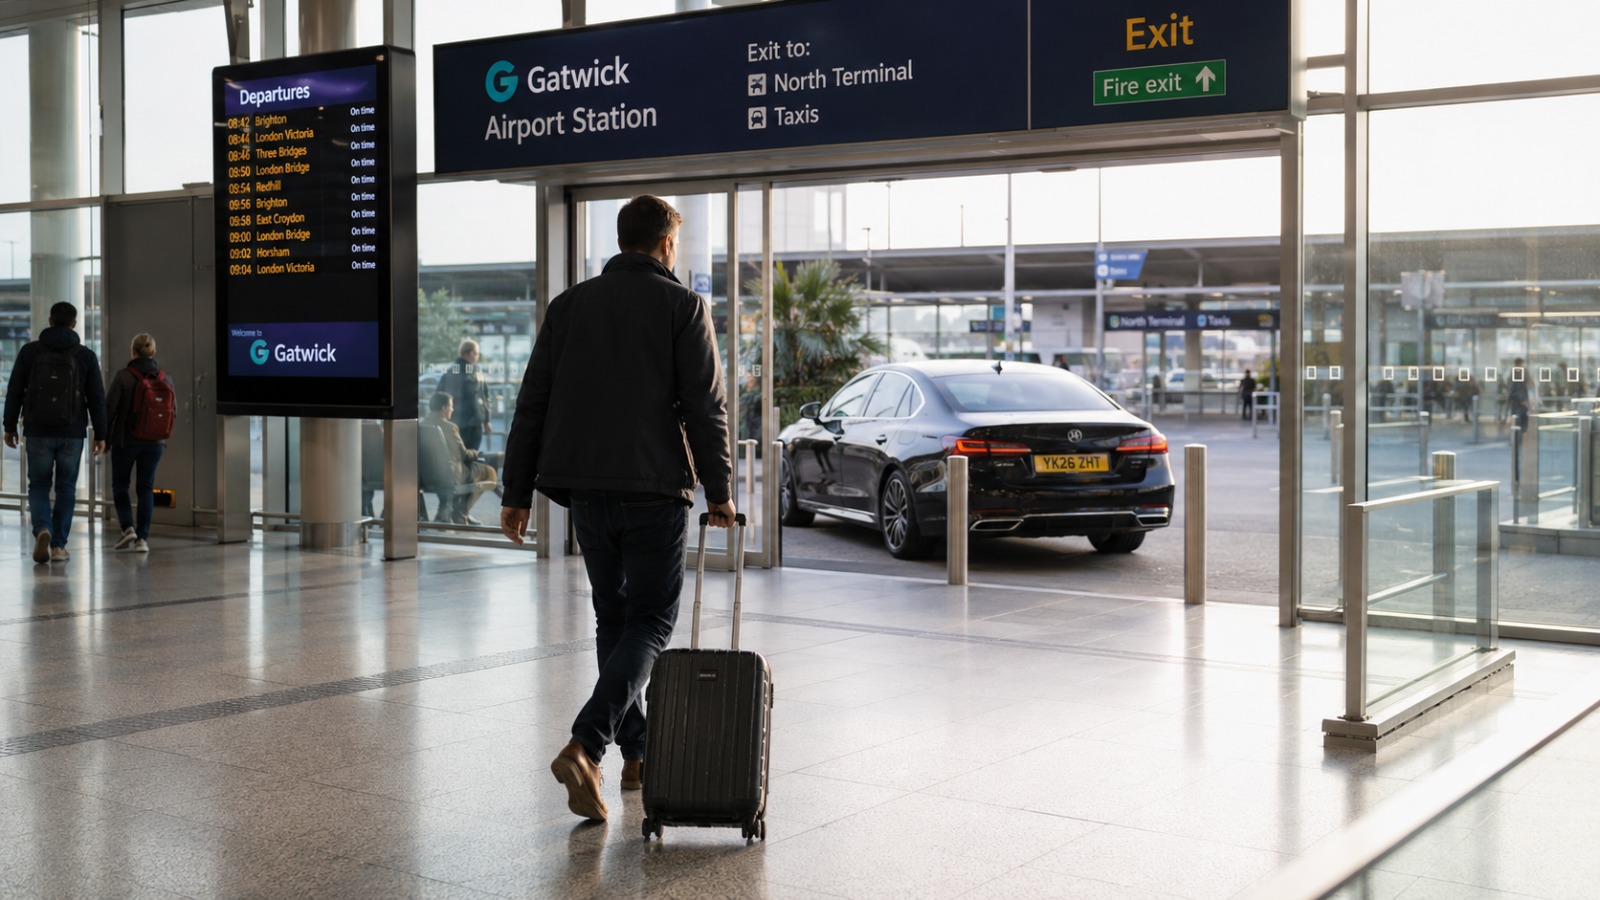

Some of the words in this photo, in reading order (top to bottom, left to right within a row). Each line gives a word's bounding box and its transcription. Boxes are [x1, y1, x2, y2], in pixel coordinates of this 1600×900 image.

[1127, 13, 1193, 51] Exit
[748, 42, 782, 62] Exit
[786, 41, 810, 59] to:
[528, 56, 630, 94] Gatwick
[774, 68, 826, 93] North
[832, 59, 913, 88] Terminal
[1104, 78, 1138, 97] Fire
[1145, 73, 1182, 93] exit
[240, 85, 310, 107] Departures
[255, 115, 287, 128] Brighton
[351, 107, 359, 115] On
[361, 106, 374, 114] time
[485, 109, 565, 145] Airport
[573, 102, 657, 133] Station
[775, 105, 819, 126] Taxis
[256, 129, 283, 142] London
[285, 128, 314, 140] Victoria
[361, 123, 375, 131] time
[256, 148, 277, 159] Three
[279, 145, 307, 158] Bridges
[351, 142, 360, 150] On
[361, 140, 375, 149] time
[256, 163, 284, 175] London
[285, 162, 310, 174] Bridge
[351, 159, 360, 167] On
[361, 158, 375, 166] time
[256, 180, 281, 192] Redhill
[351, 176, 360, 184] On
[361, 175, 375, 183] time
[256, 197, 287, 210] Brighton
[351, 193, 360, 201] On
[362, 192, 375, 200] time
[257, 214, 272, 225] East
[273, 213, 304, 226] Croydon
[352, 210, 360, 218] On
[362, 209, 375, 217] time
[257, 231, 284, 241] London
[286, 229, 310, 241] Bridge
[352, 227, 360, 236] On
[362, 226, 375, 234] time
[257, 247, 290, 258] Horsham
[362, 243, 375, 252] time
[257, 263, 284, 274] London
[286, 262, 314, 273] Victoria
[352, 262, 360, 270] On
[362, 260, 375, 269] time
[1121, 316, 1146, 328] North
[1148, 316, 1185, 326] Terminal
[1208, 315, 1231, 326] Taxis
[275, 343, 336, 362] Gatwick
[1043, 457, 1075, 469] YK26
[1079, 456, 1101, 468] ZHT
